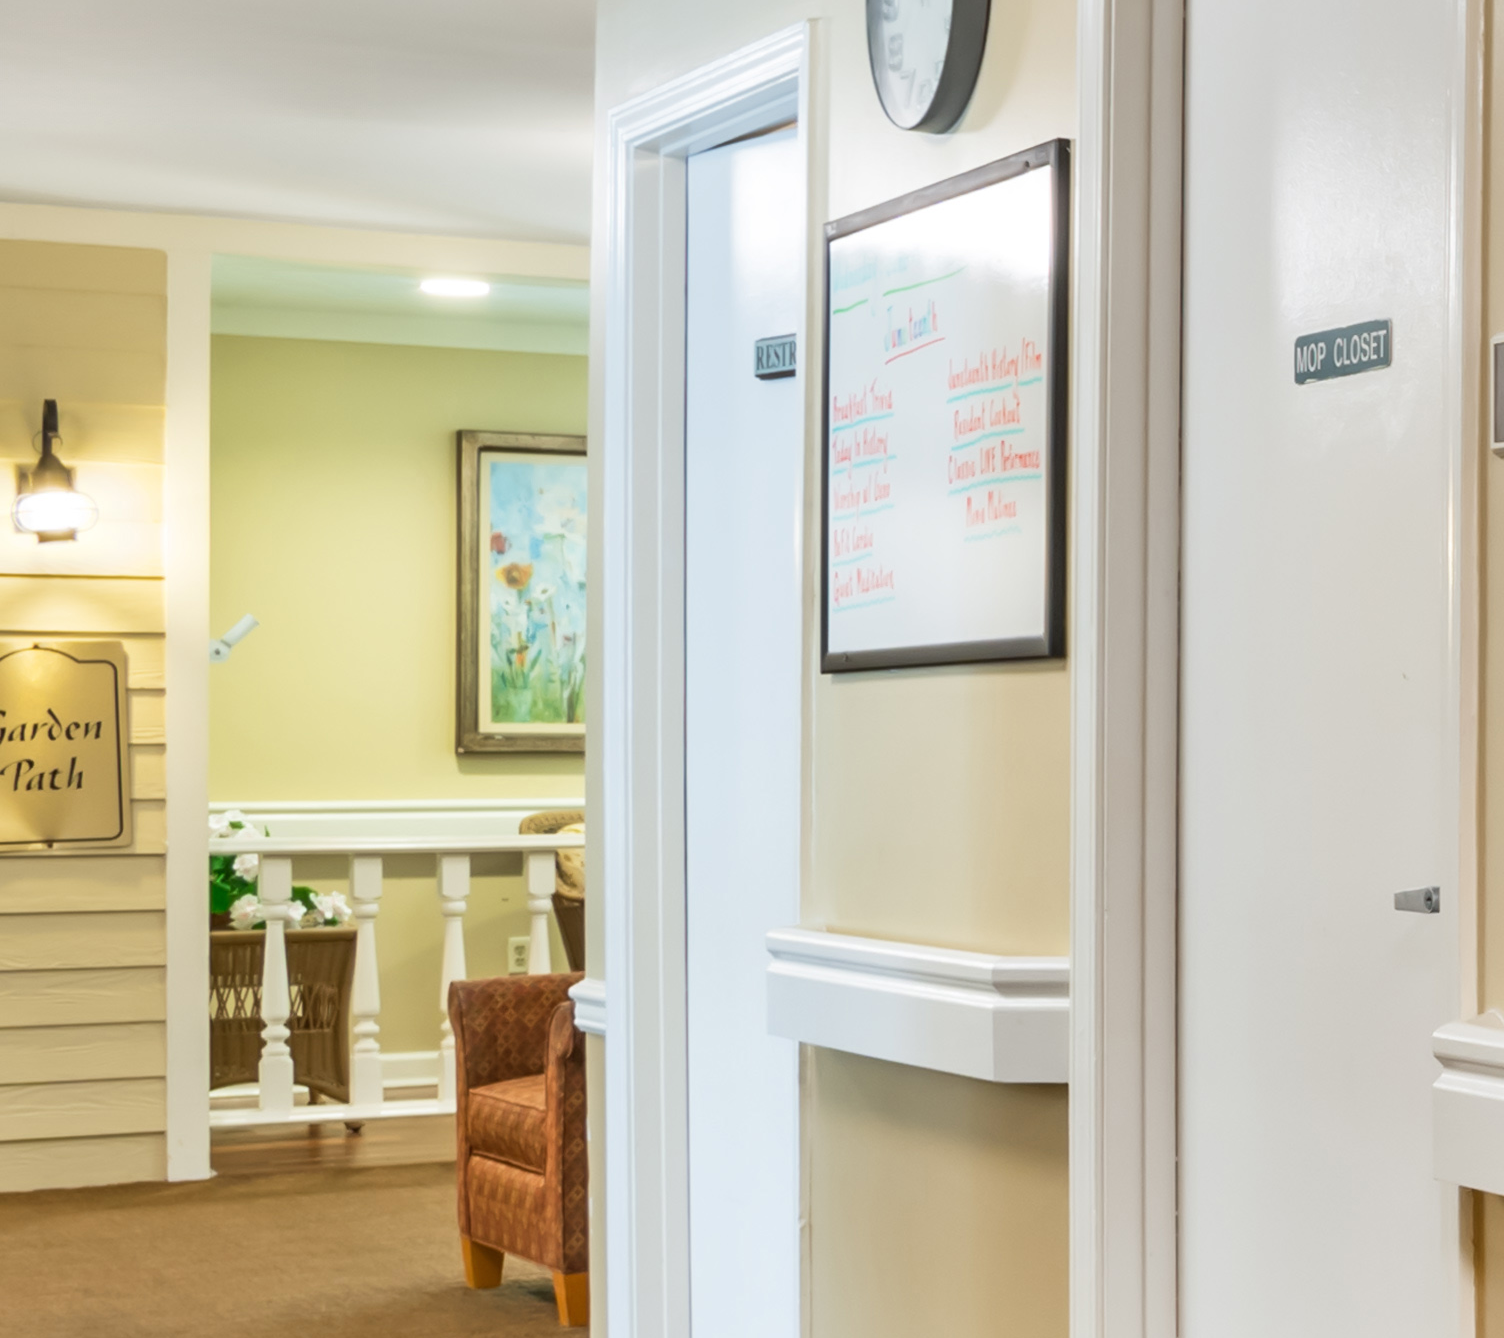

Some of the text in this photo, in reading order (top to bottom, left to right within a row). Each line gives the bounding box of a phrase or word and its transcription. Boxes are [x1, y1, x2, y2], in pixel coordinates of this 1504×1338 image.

[1296, 329, 1387, 374] MOP CLOSET
[0, 756, 84, 792] Path
